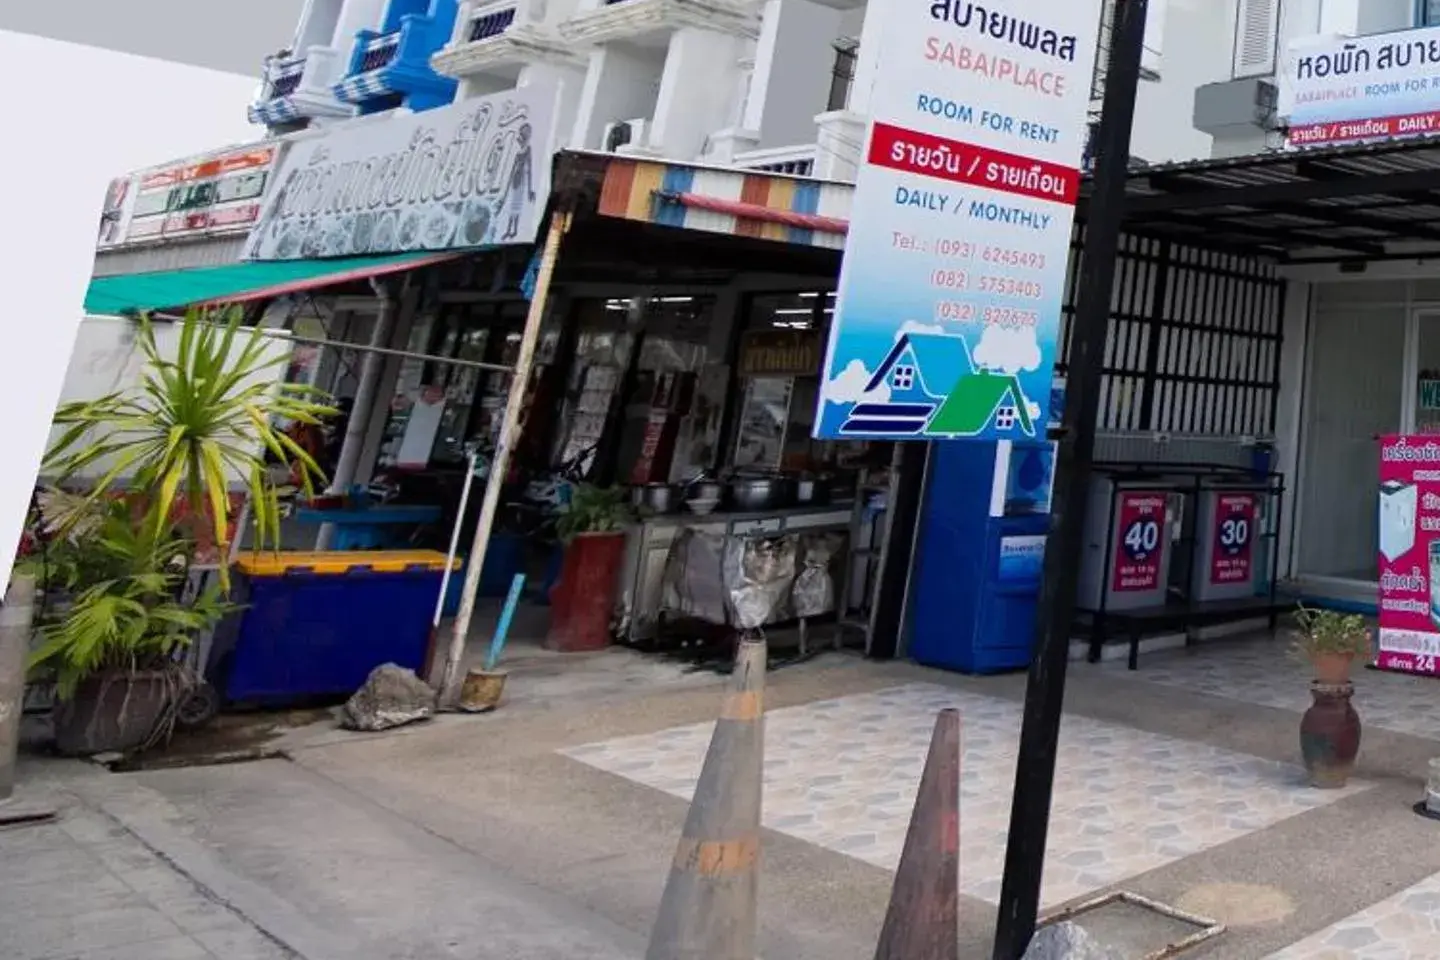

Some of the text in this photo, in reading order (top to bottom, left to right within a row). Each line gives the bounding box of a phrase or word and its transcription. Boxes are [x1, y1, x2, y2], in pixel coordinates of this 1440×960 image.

[924, 37, 1066, 96] SABAIPLACE
[1298, 43, 1369, 80] หอพัก
[1365, 83, 1399, 95] ROOM
[1405, 77, 1427, 90] FOR
[917, 95, 1059, 142] ROOM FOR RENT
[1399, 115, 1435, 132] DAILY
[891, 140, 1066, 195] รายวัน / รายเดือน
[895, 187, 949, 212] DAILY
[969, 200, 1050, 230] MONTHLY
[1125, 521, 1159, 551] 40
[1221, 519, 1248, 545] 30
[1416, 655, 1435, 671] 24
